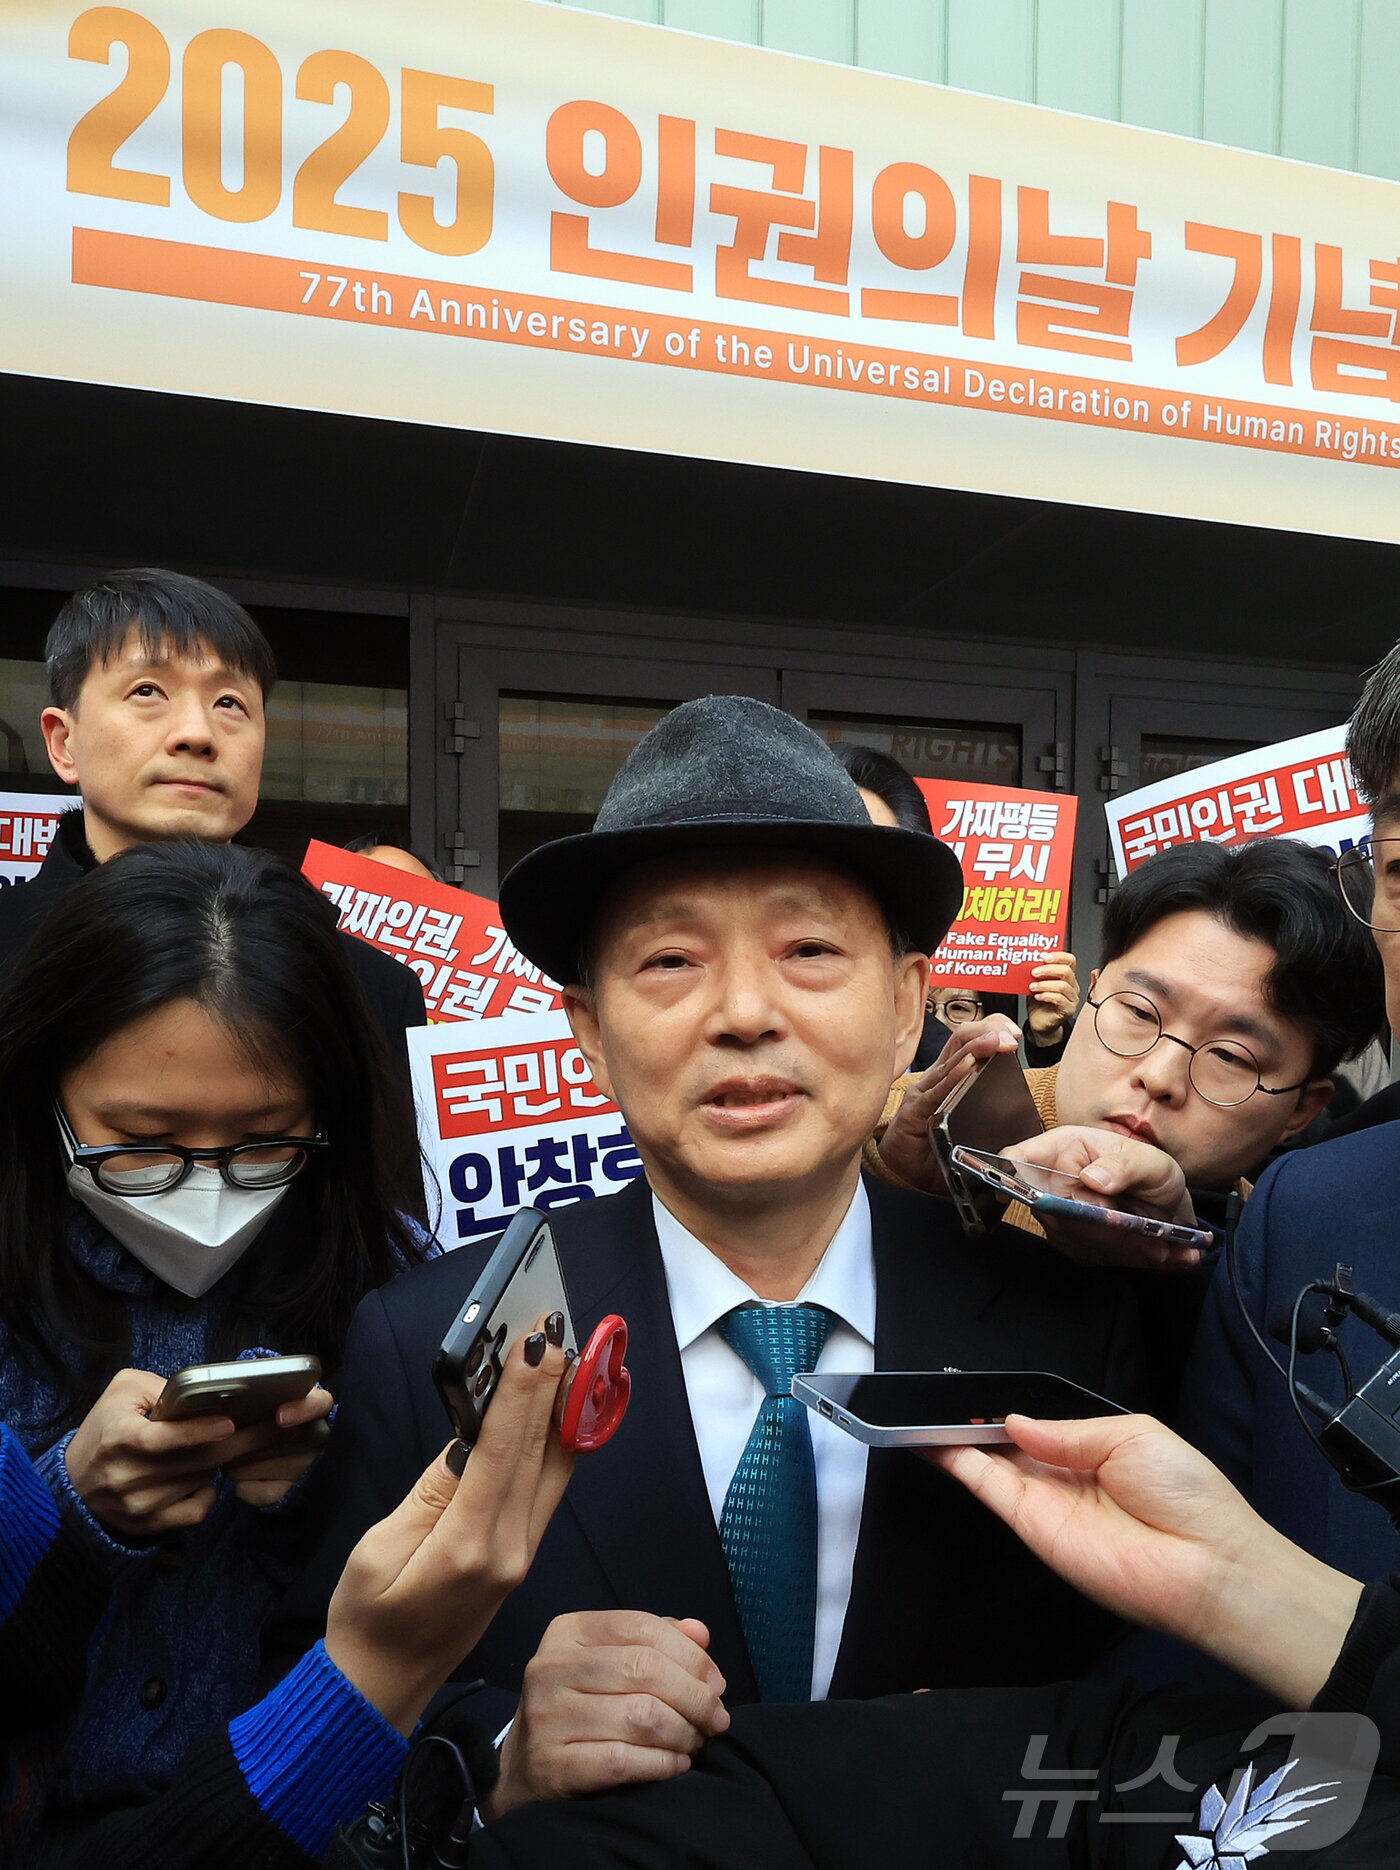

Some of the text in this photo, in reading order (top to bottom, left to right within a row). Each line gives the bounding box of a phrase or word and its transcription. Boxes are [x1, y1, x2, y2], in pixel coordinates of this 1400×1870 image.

[66, 6, 495, 256] 2025
[546, 100, 1152, 362] 인권의날
[299, 271, 1400, 460] 77th Anniversary of the Universal Declaration of Human Rights
[891, 731, 1014, 769] RIGHTS
[940, 799, 1059, 842] 가짜평등
[1124, 777, 1283, 862] 국민인권
[972, 842, 1051, 883] 무시
[320, 880, 464, 962] 가짜인권,
[956, 886, 1062, 924] 체하라!
[934, 946, 992, 961] Human
[945, 931, 1058, 949] Fake Equality!
[380, 949, 500, 1020] 인권
[935, 961, 955, 975] of
[954, 962, 1008, 977] Korea!
